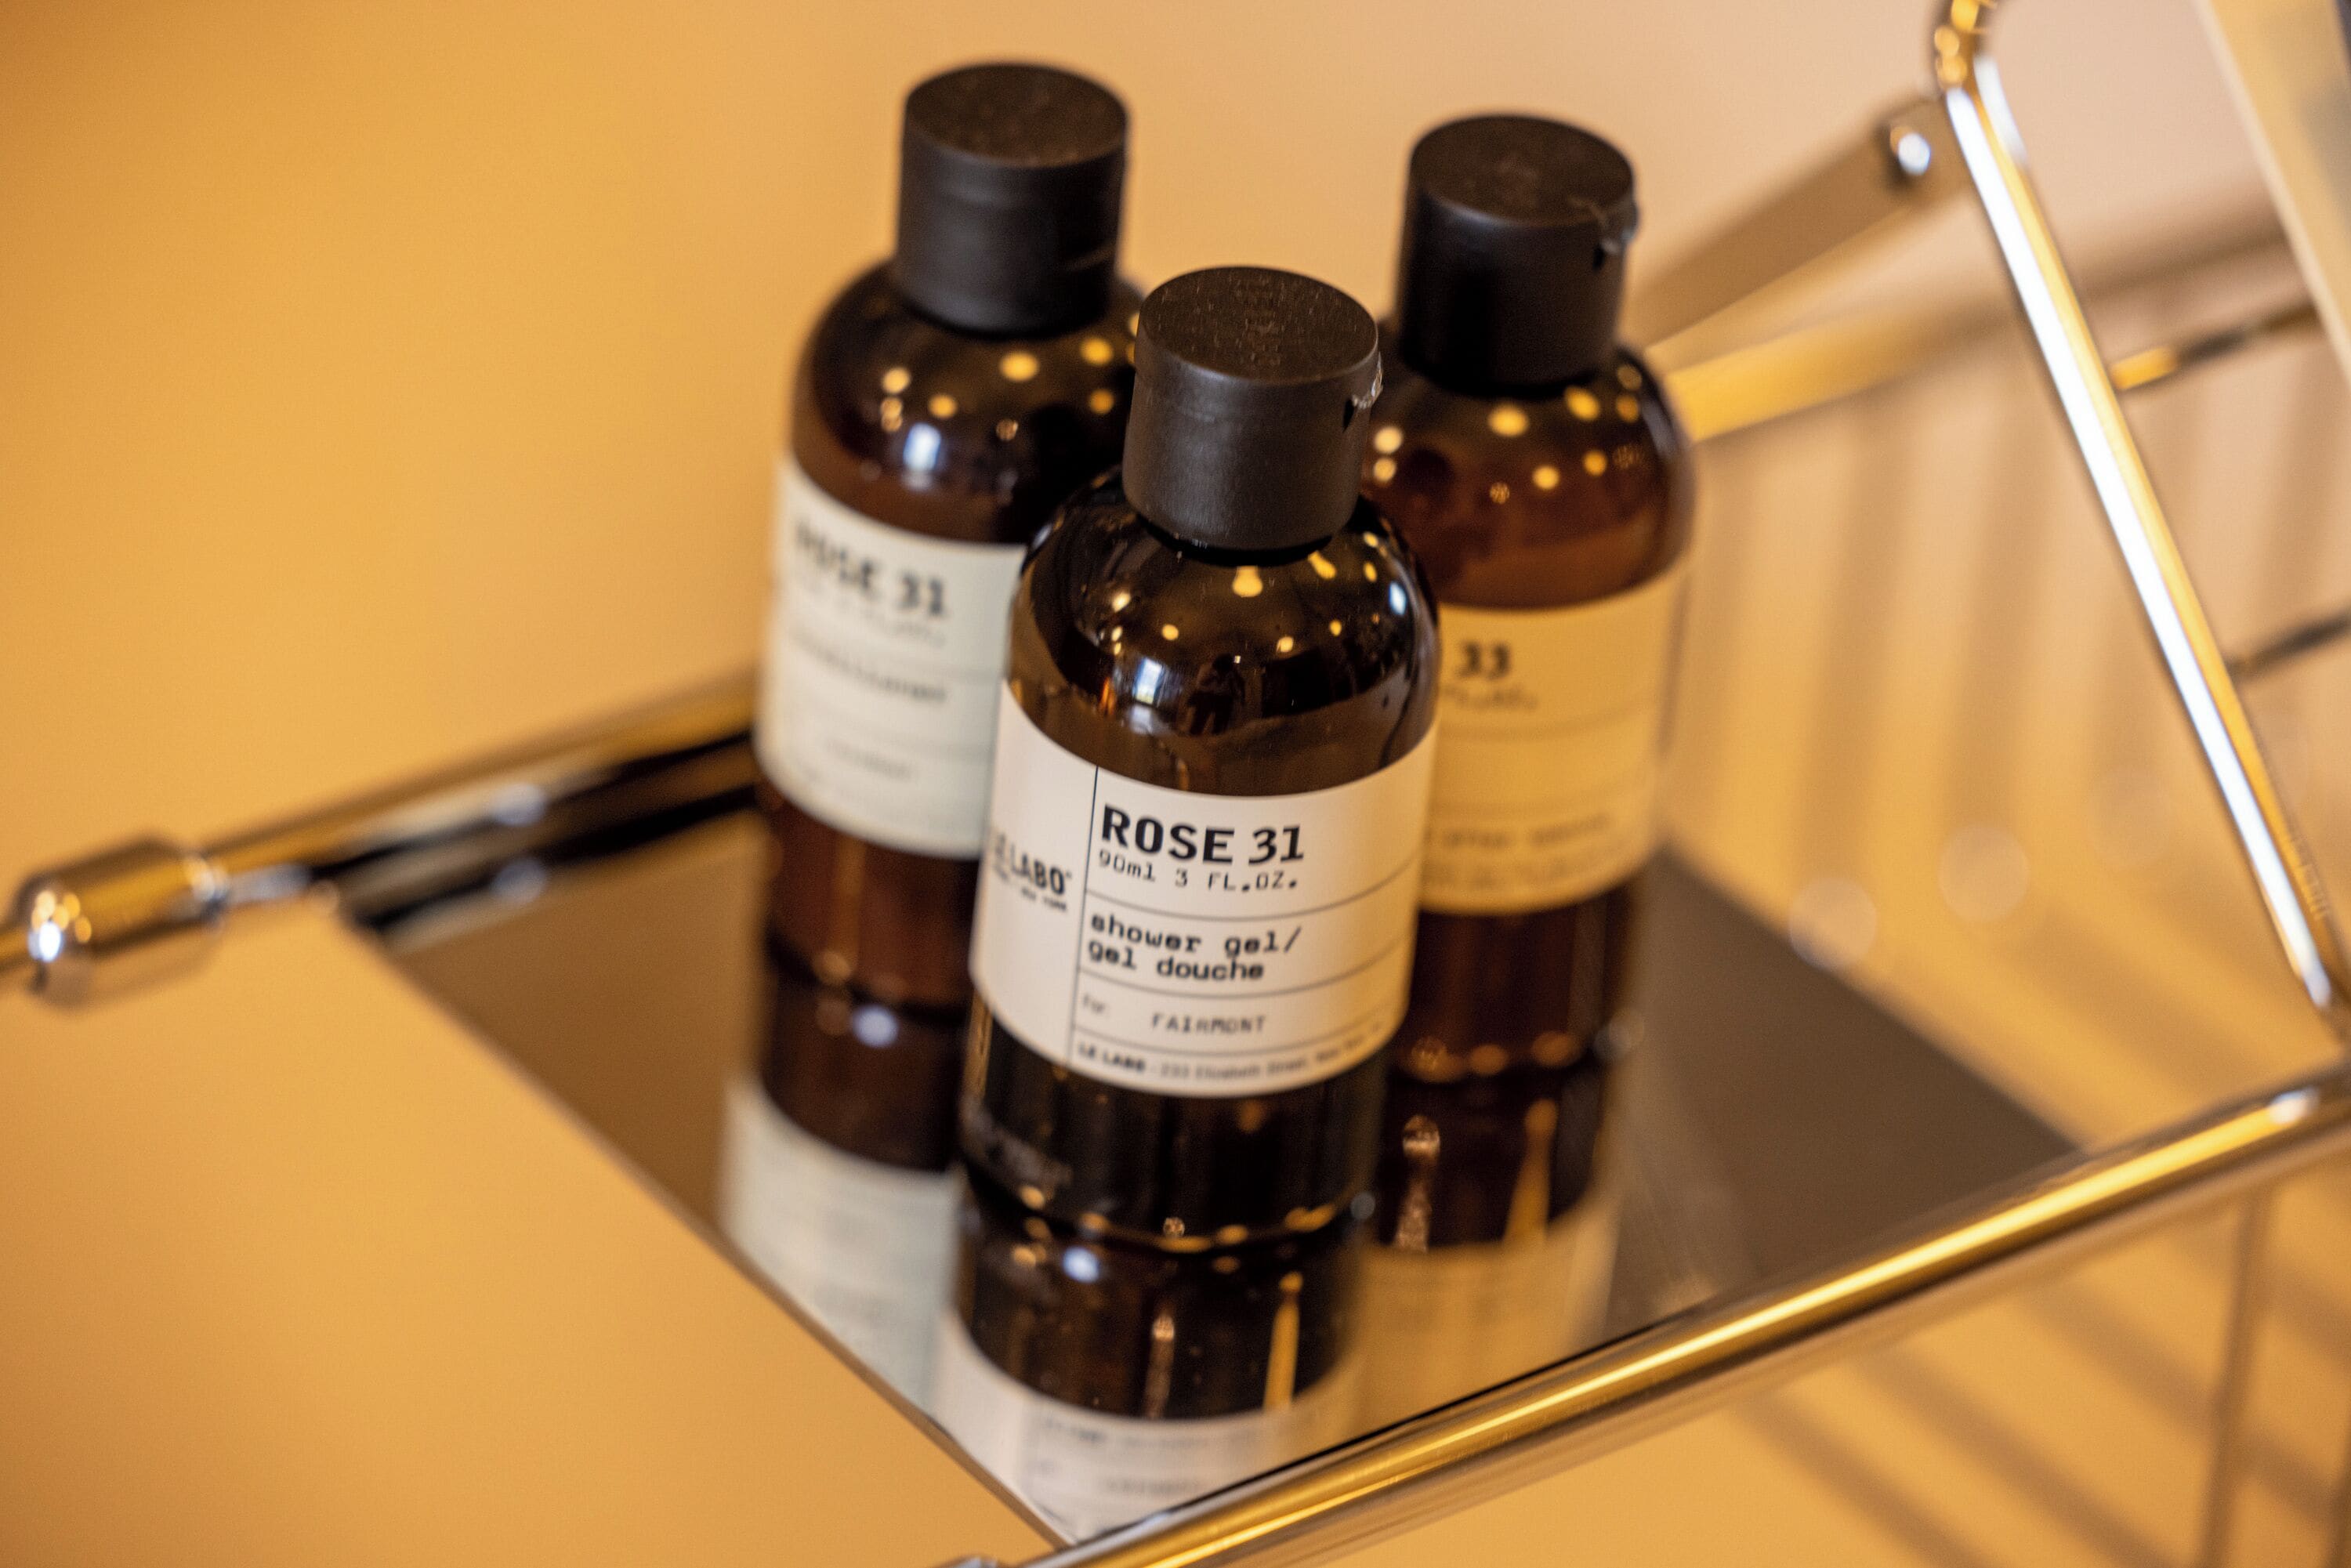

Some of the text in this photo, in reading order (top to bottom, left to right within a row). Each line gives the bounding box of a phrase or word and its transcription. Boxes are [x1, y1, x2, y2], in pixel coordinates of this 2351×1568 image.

[1102, 804, 1305, 865] ROSE 31
[1099, 849, 1156, 882] 90ml
[1175, 868, 1188, 887] 3
[1091, 913, 1302, 958] shower gel/
[1089, 940, 1264, 981] gel douche
[1151, 1012, 1266, 1034] FAIRMONT
